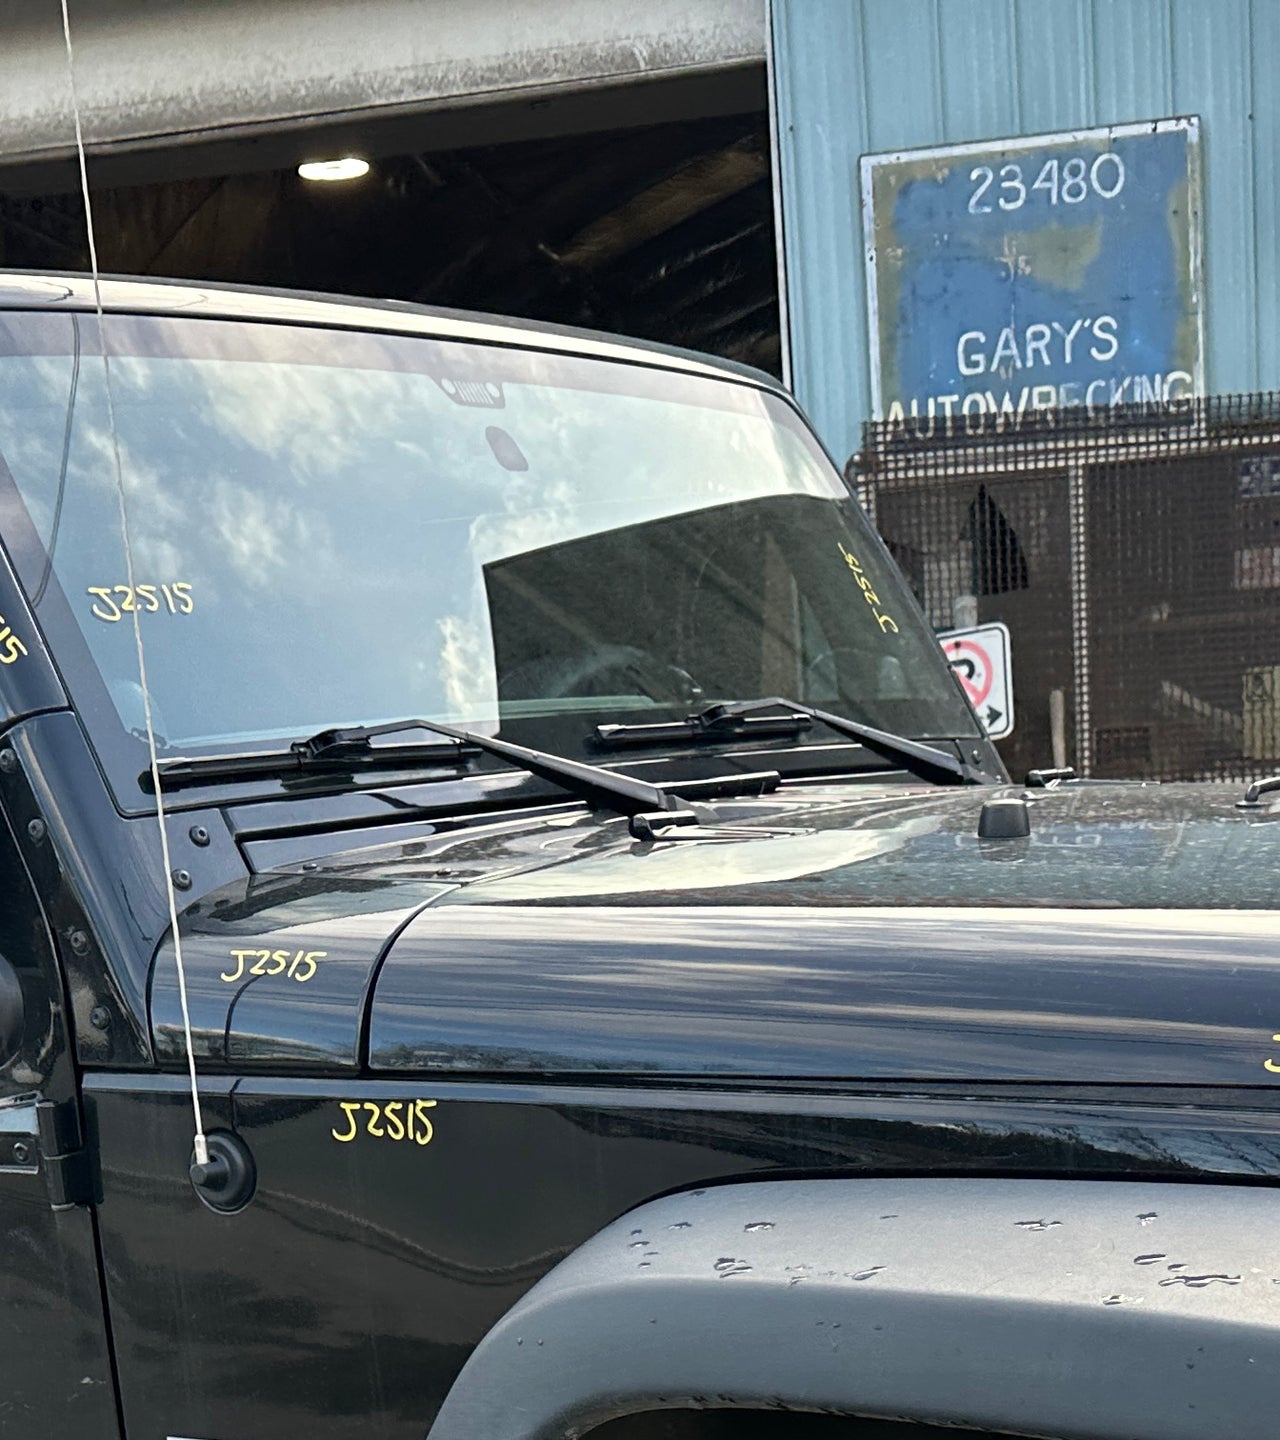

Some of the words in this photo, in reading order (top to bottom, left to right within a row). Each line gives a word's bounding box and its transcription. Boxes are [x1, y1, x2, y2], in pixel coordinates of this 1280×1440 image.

[968, 152, 1125, 213] 23480
[957, 315, 1118, 376] GARY'S
[87, 582, 194, 622] J2515
[221, 950, 327, 982] J2515
[332, 1099, 437, 1145] J2515
